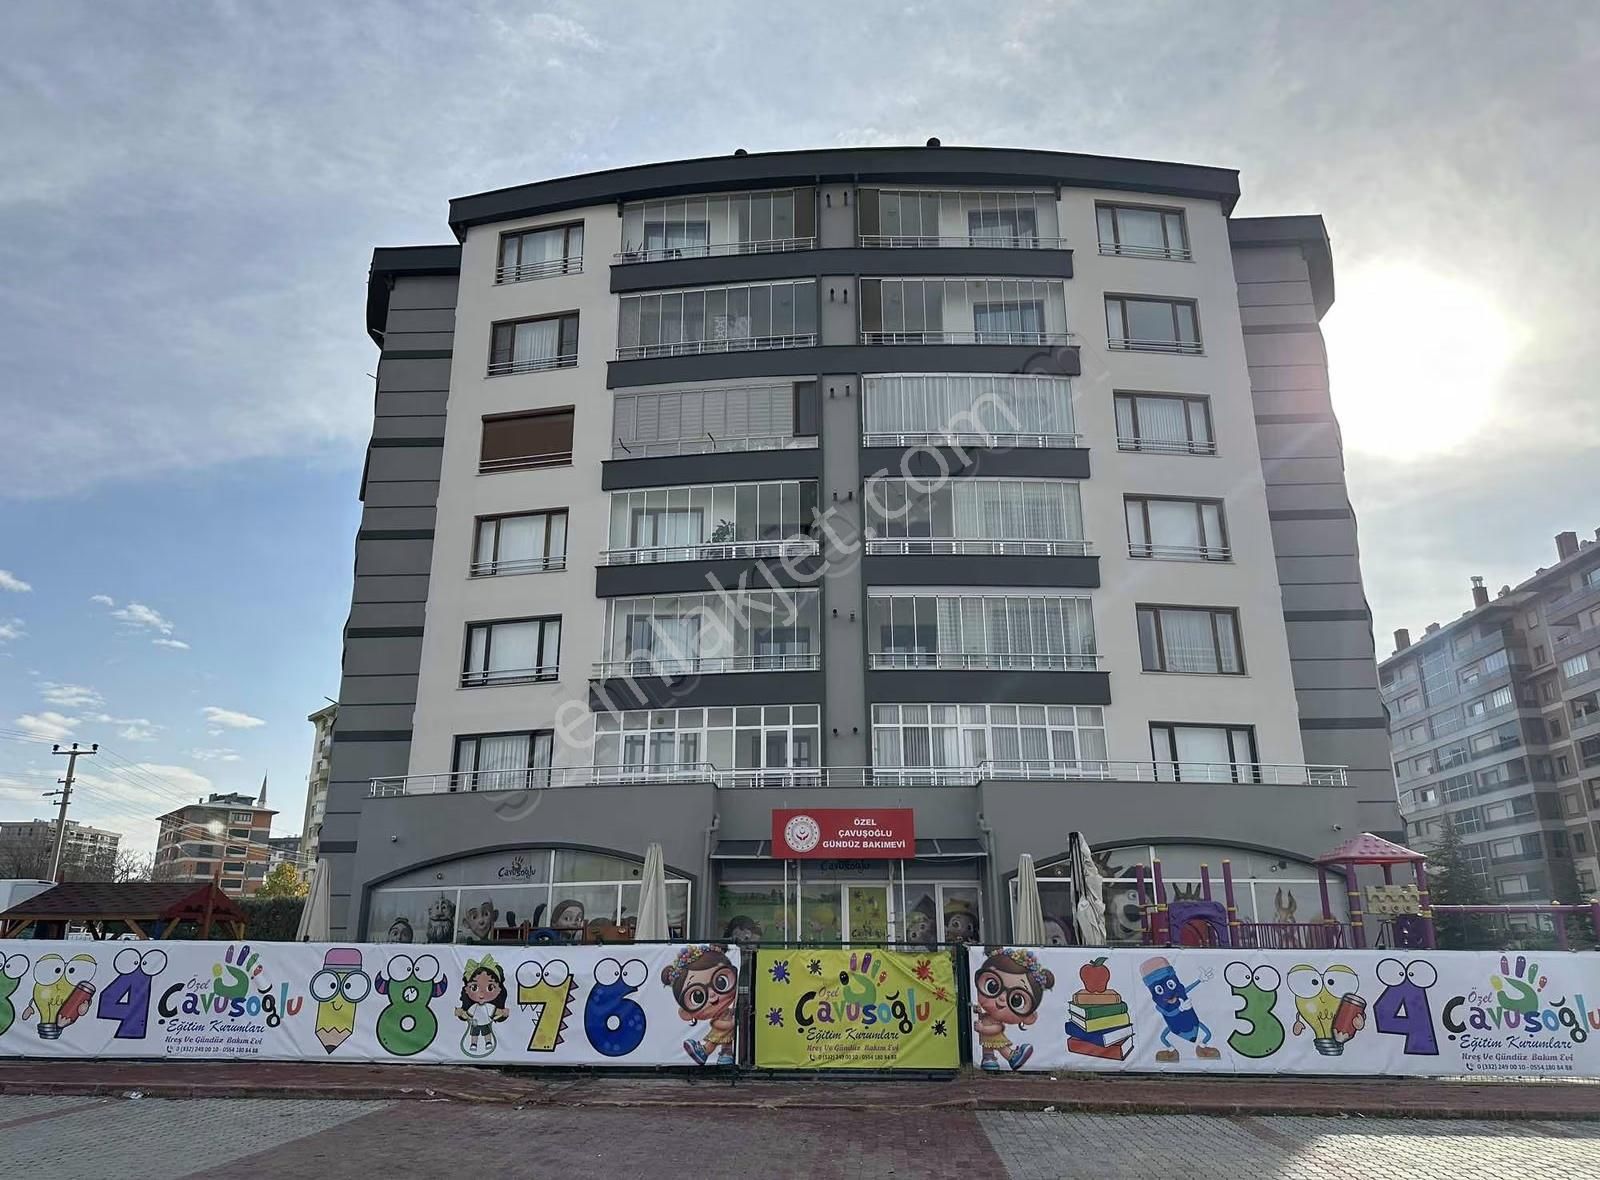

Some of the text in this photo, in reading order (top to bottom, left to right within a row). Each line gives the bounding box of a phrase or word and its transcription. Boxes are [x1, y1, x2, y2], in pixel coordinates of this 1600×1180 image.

[853, 816, 877, 826] ÖZEL
[838, 828, 893, 839] ÇAVUŞOĞLU
[822, 839, 906, 849] GÜNDÜZ BAKIMEVİ
[187, 974, 211, 992] Özel
[818, 985, 840, 1000] Özel
[1467, 986, 1493, 1006] Özel
[157, 982, 304, 1028] Çavuşoğlu
[376, 969, 438, 1056] 8
[517, 974, 575, 1052] 7
[794, 987, 930, 1034] Çavuşoğlu
[584, 974, 647, 1057] 6
[1227, 984, 1285, 1058] 3
[1373, 984, 1440, 1055] 4
[1442, 994, 1600, 1043] Çavuşoğlu
[166, 1019, 265, 1035] Eğitim Kurumları
[806, 1027, 899, 1043] Eğitim Kurumları
[184, 1036, 193, 1045] Ve
[195, 1036, 223, 1045] Gündüz
[1460, 1034, 1573, 1052] Eğitim Kurumları
[1483, 1053, 1494, 1061] Ve
[1495, 1053, 1527, 1061] Gündüz
[1531, 1053, 1558, 1061] Bakım
[1560, 1053, 1573, 1061] Evi
